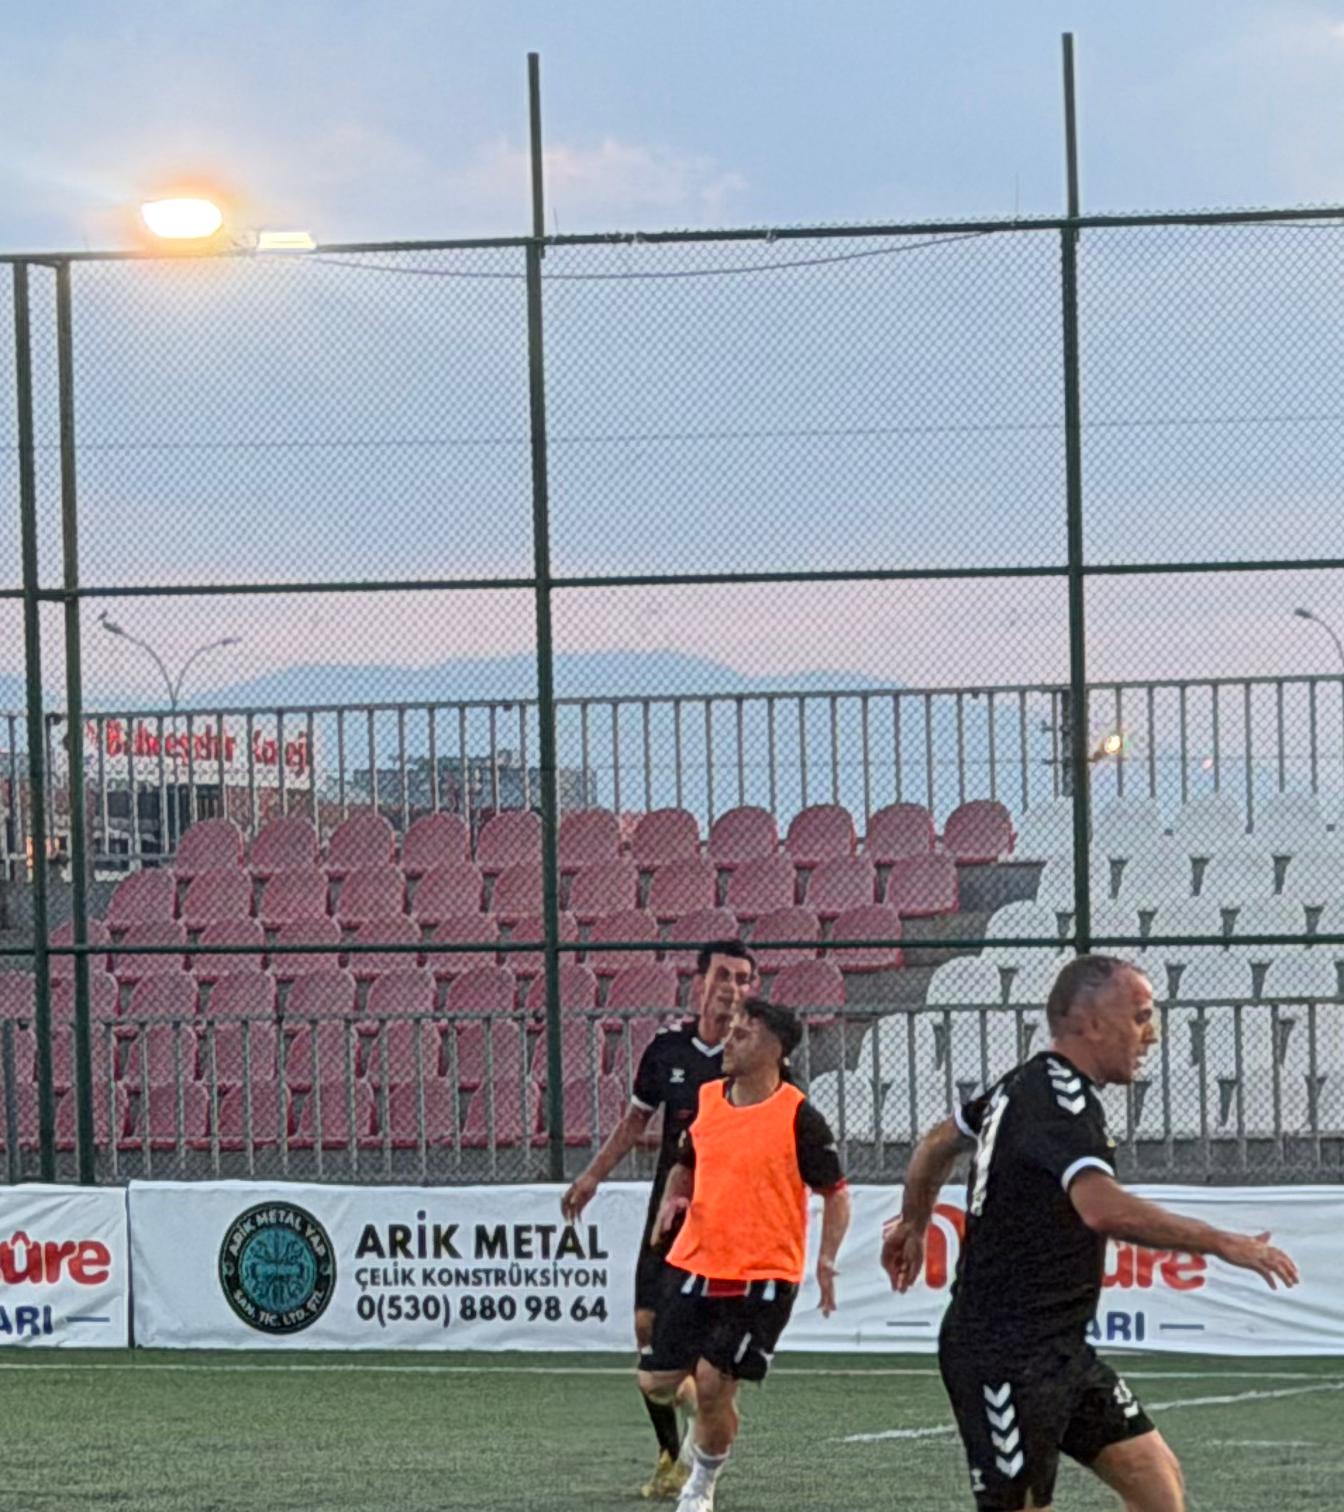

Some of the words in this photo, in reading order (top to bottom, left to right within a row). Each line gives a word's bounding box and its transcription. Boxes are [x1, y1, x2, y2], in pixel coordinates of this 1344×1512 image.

[256, 1208, 303, 1232] METAL
[355, 1209, 463, 1260] ARİK
[474, 1223, 609, 1260] METAL
[355, 1261, 416, 1291] ÇELİK
[422, 1263, 608, 1288] KONSTRÜKSİYON
[357, 1294, 450, 1328] 0(530)
[459, 1295, 517, 1321] 880
[525, 1296, 562, 1322] 98
[570, 1296, 608, 1322] 64
